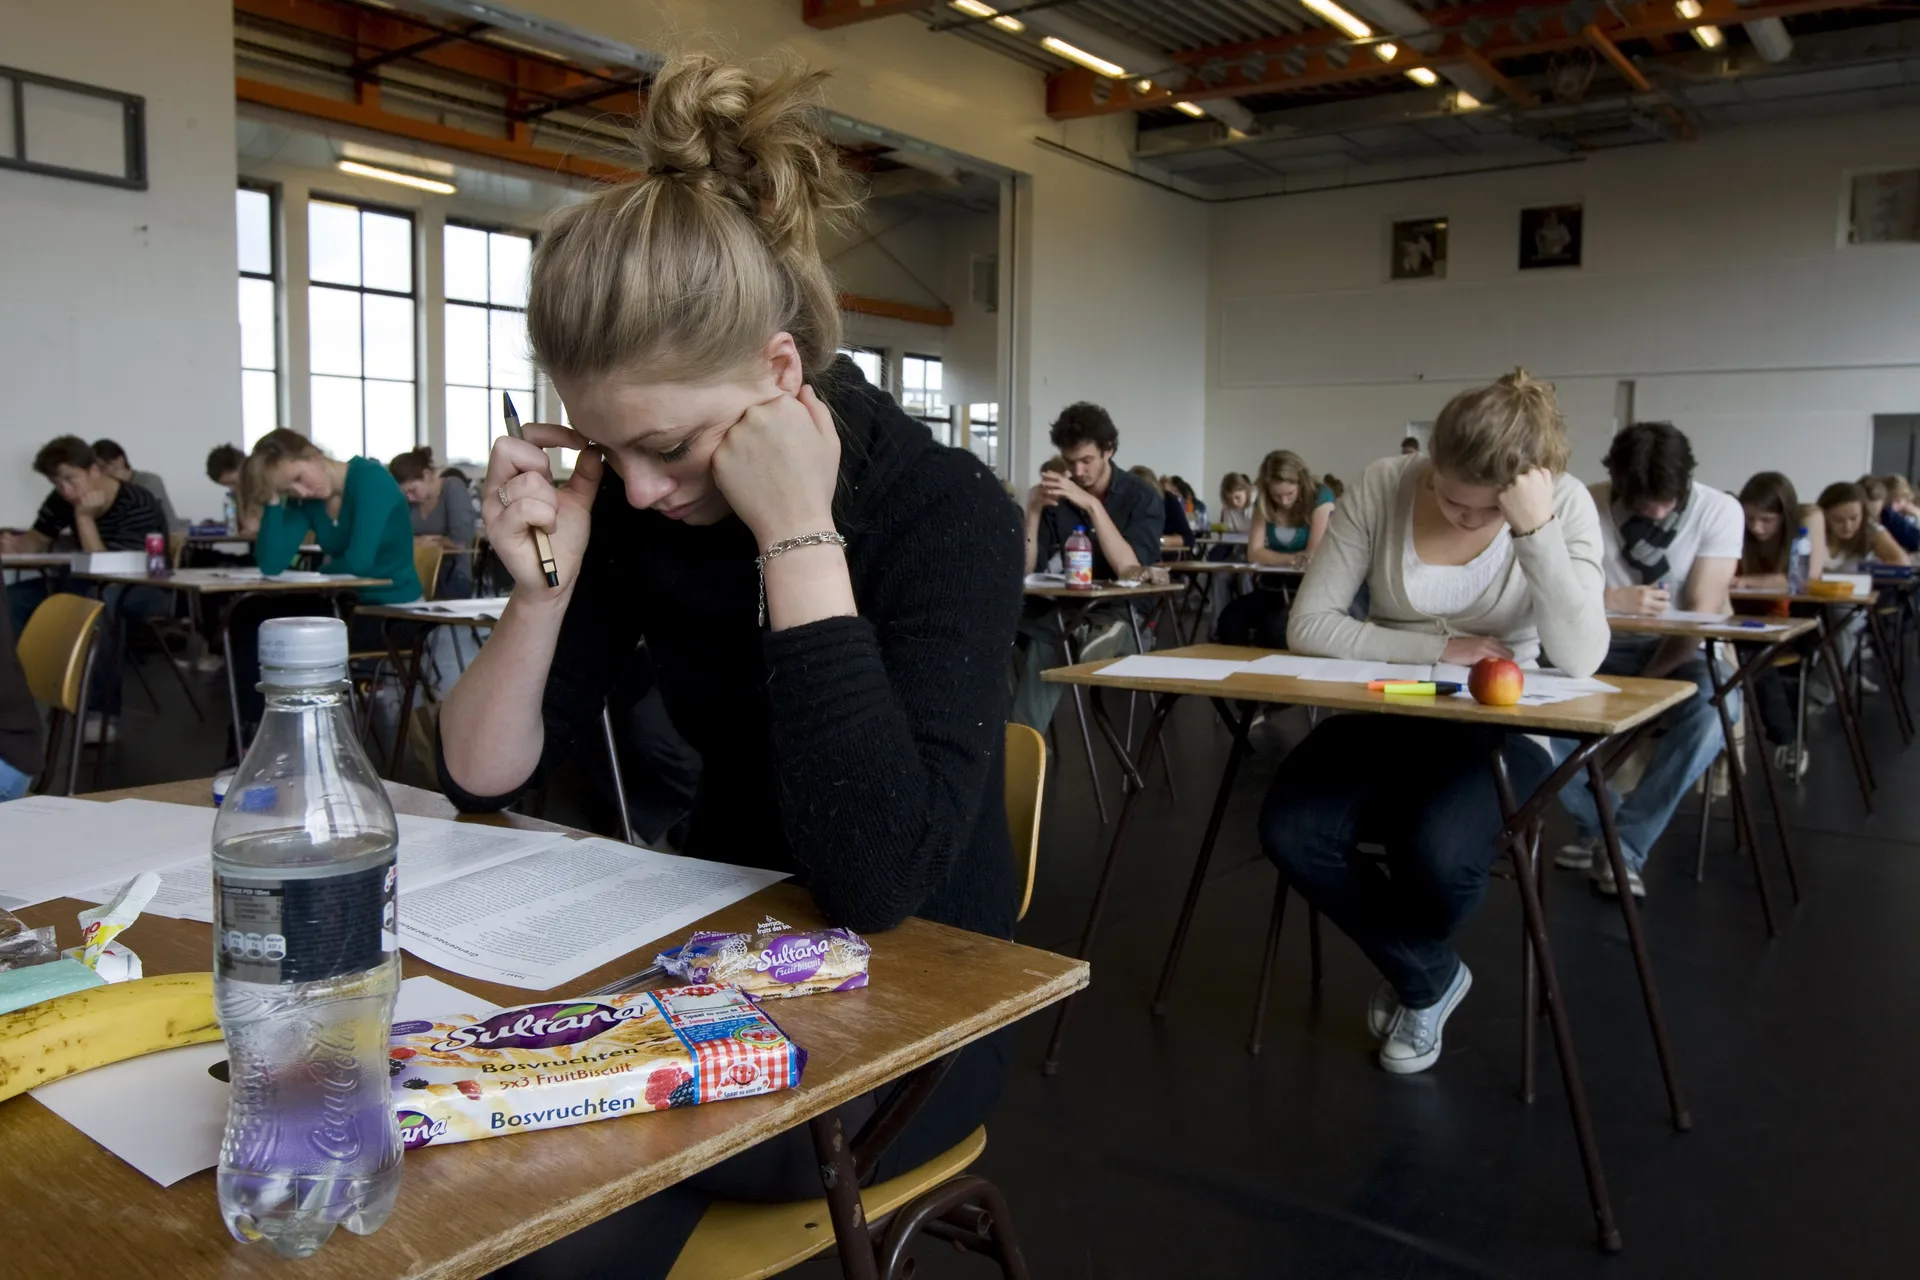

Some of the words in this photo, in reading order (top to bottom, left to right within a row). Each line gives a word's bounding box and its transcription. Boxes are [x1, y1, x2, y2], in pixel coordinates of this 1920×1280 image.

[755, 940, 830, 972] Sultana
[431, 1003, 646, 1052] Sultana
[482, 1048, 638, 1073] Bosvruchten
[501, 1076, 531, 1090] 5x3
[537, 1062, 633, 1086] FruitBiscuit
[491, 1097, 635, 1129] Bosvruchten
